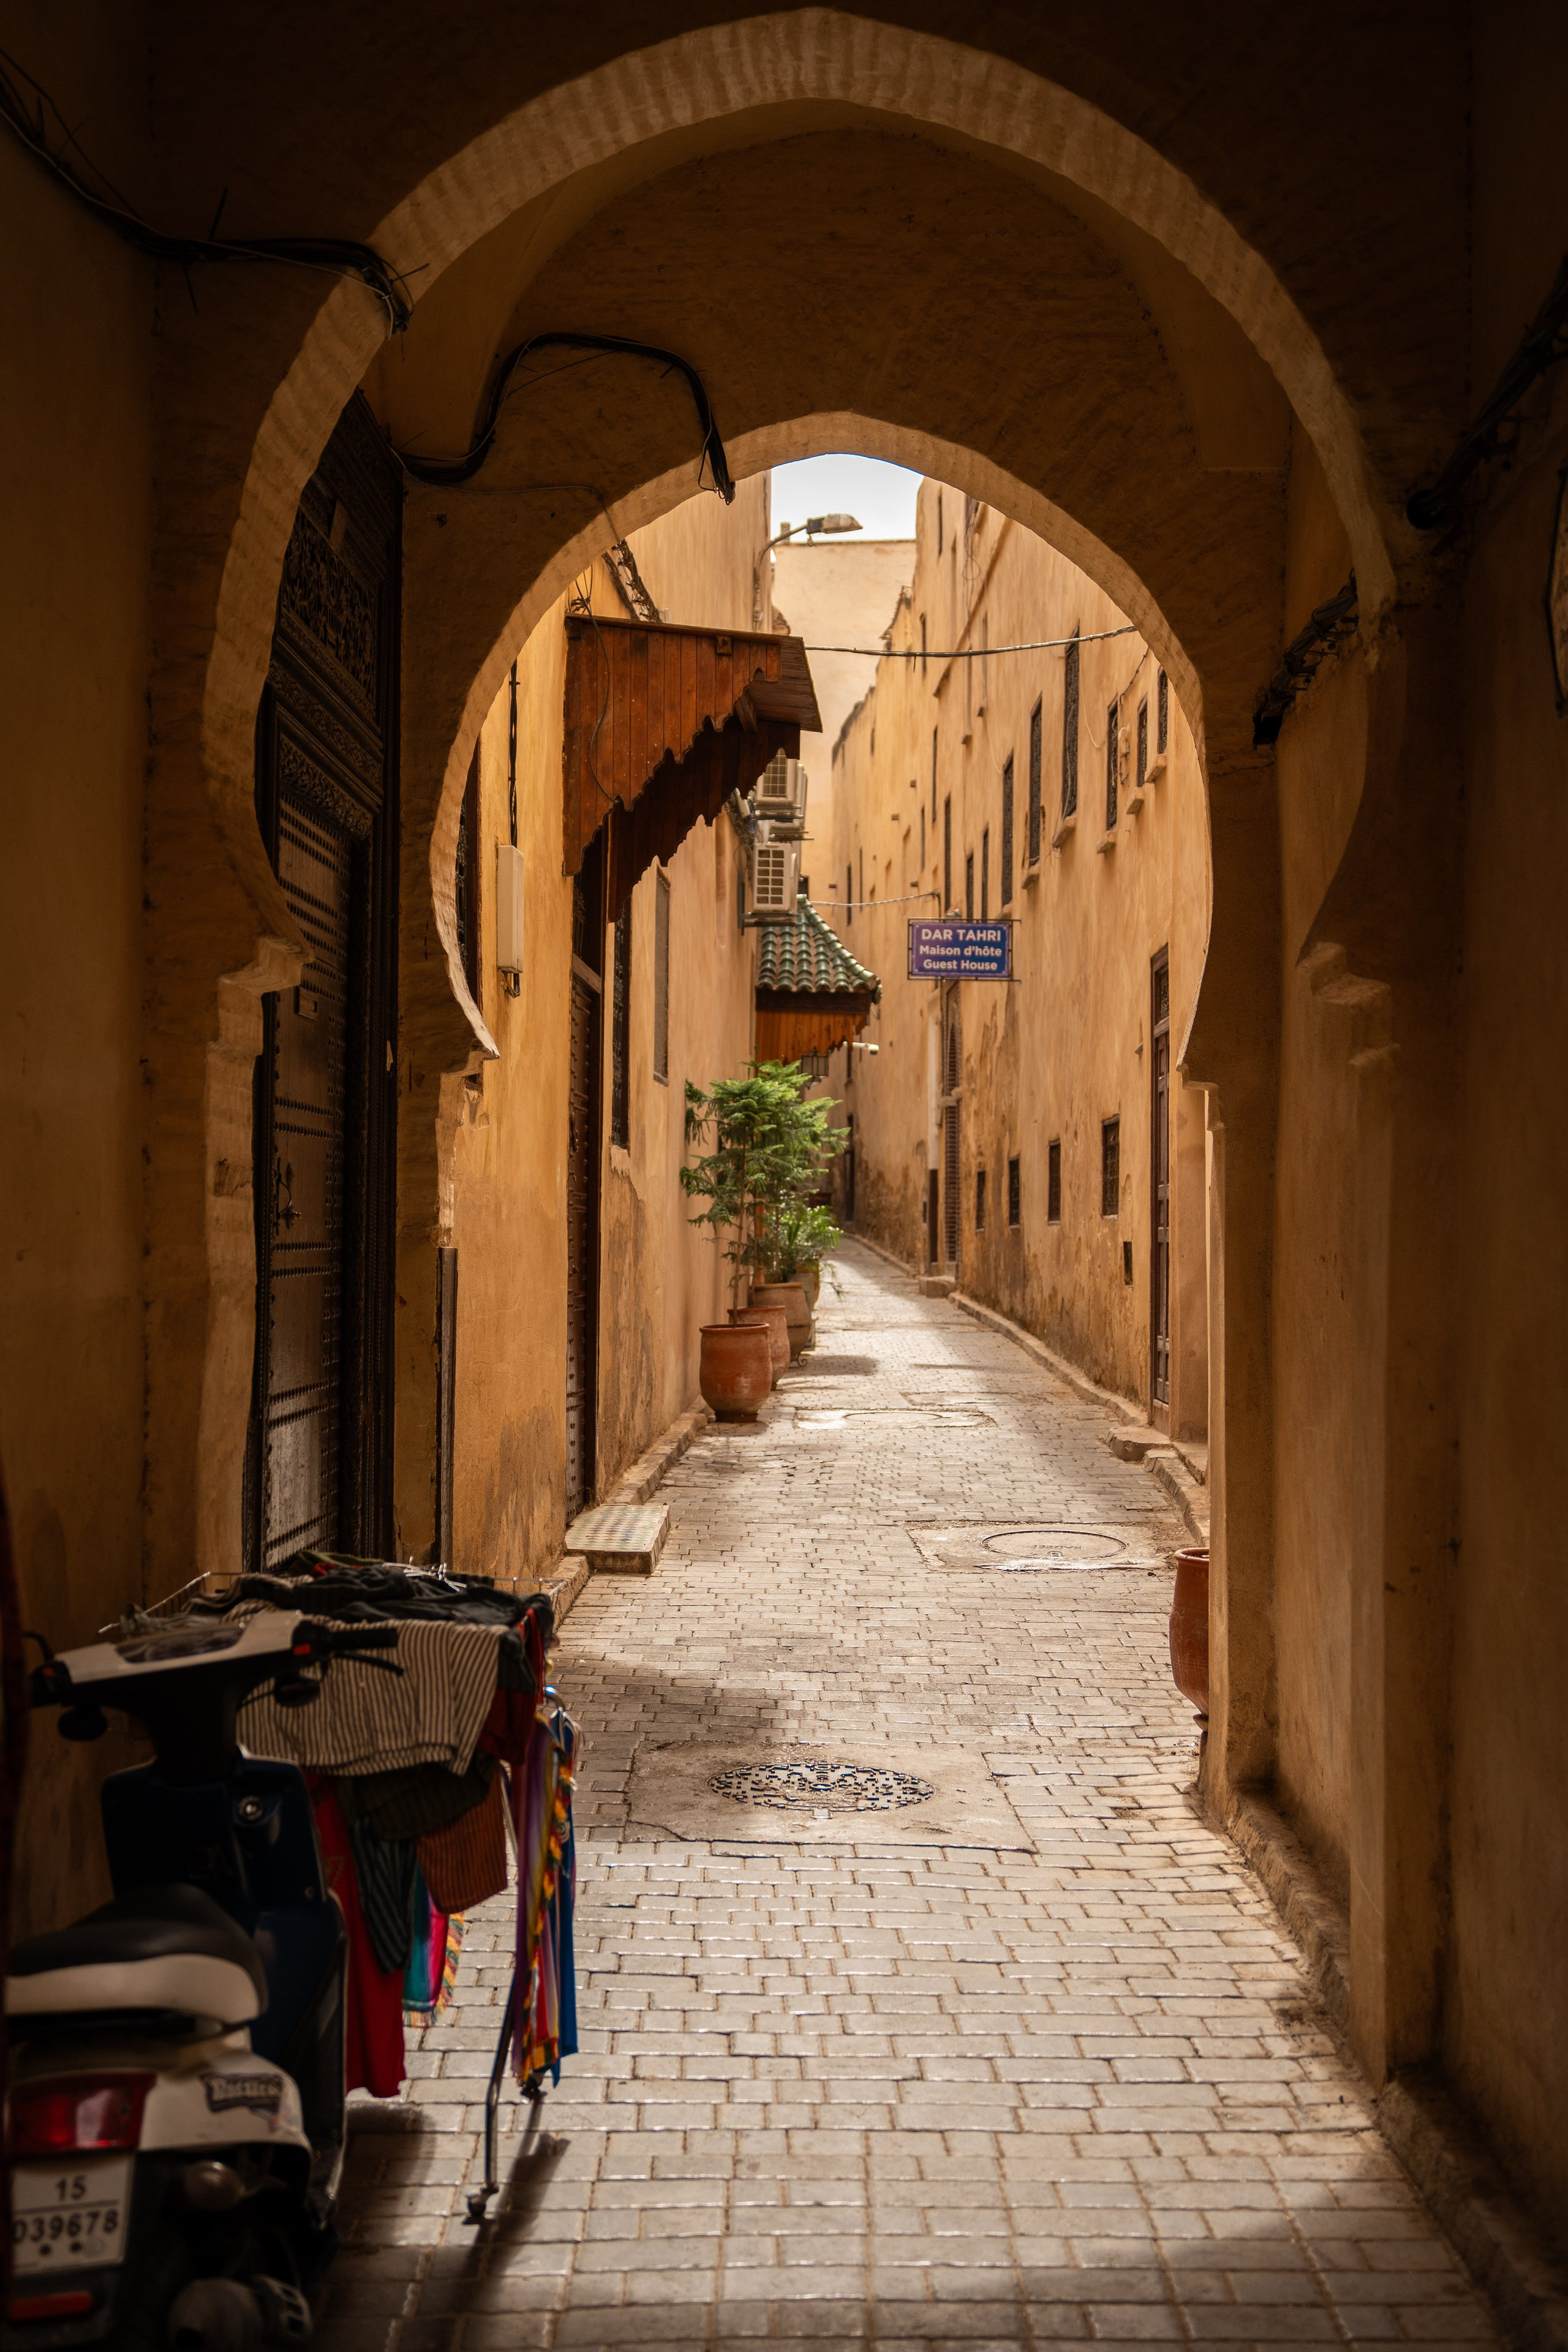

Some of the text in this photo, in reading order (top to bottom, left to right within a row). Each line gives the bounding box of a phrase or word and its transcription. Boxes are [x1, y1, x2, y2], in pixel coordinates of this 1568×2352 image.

[921, 929, 1001, 942] DAR TAHRI
[919, 944, 1002, 957] Maison d'hôte
[923, 959, 998, 970] Guest House
[57, 2174, 86, 2201] 15
[12, 2209, 118, 2244] 039678
